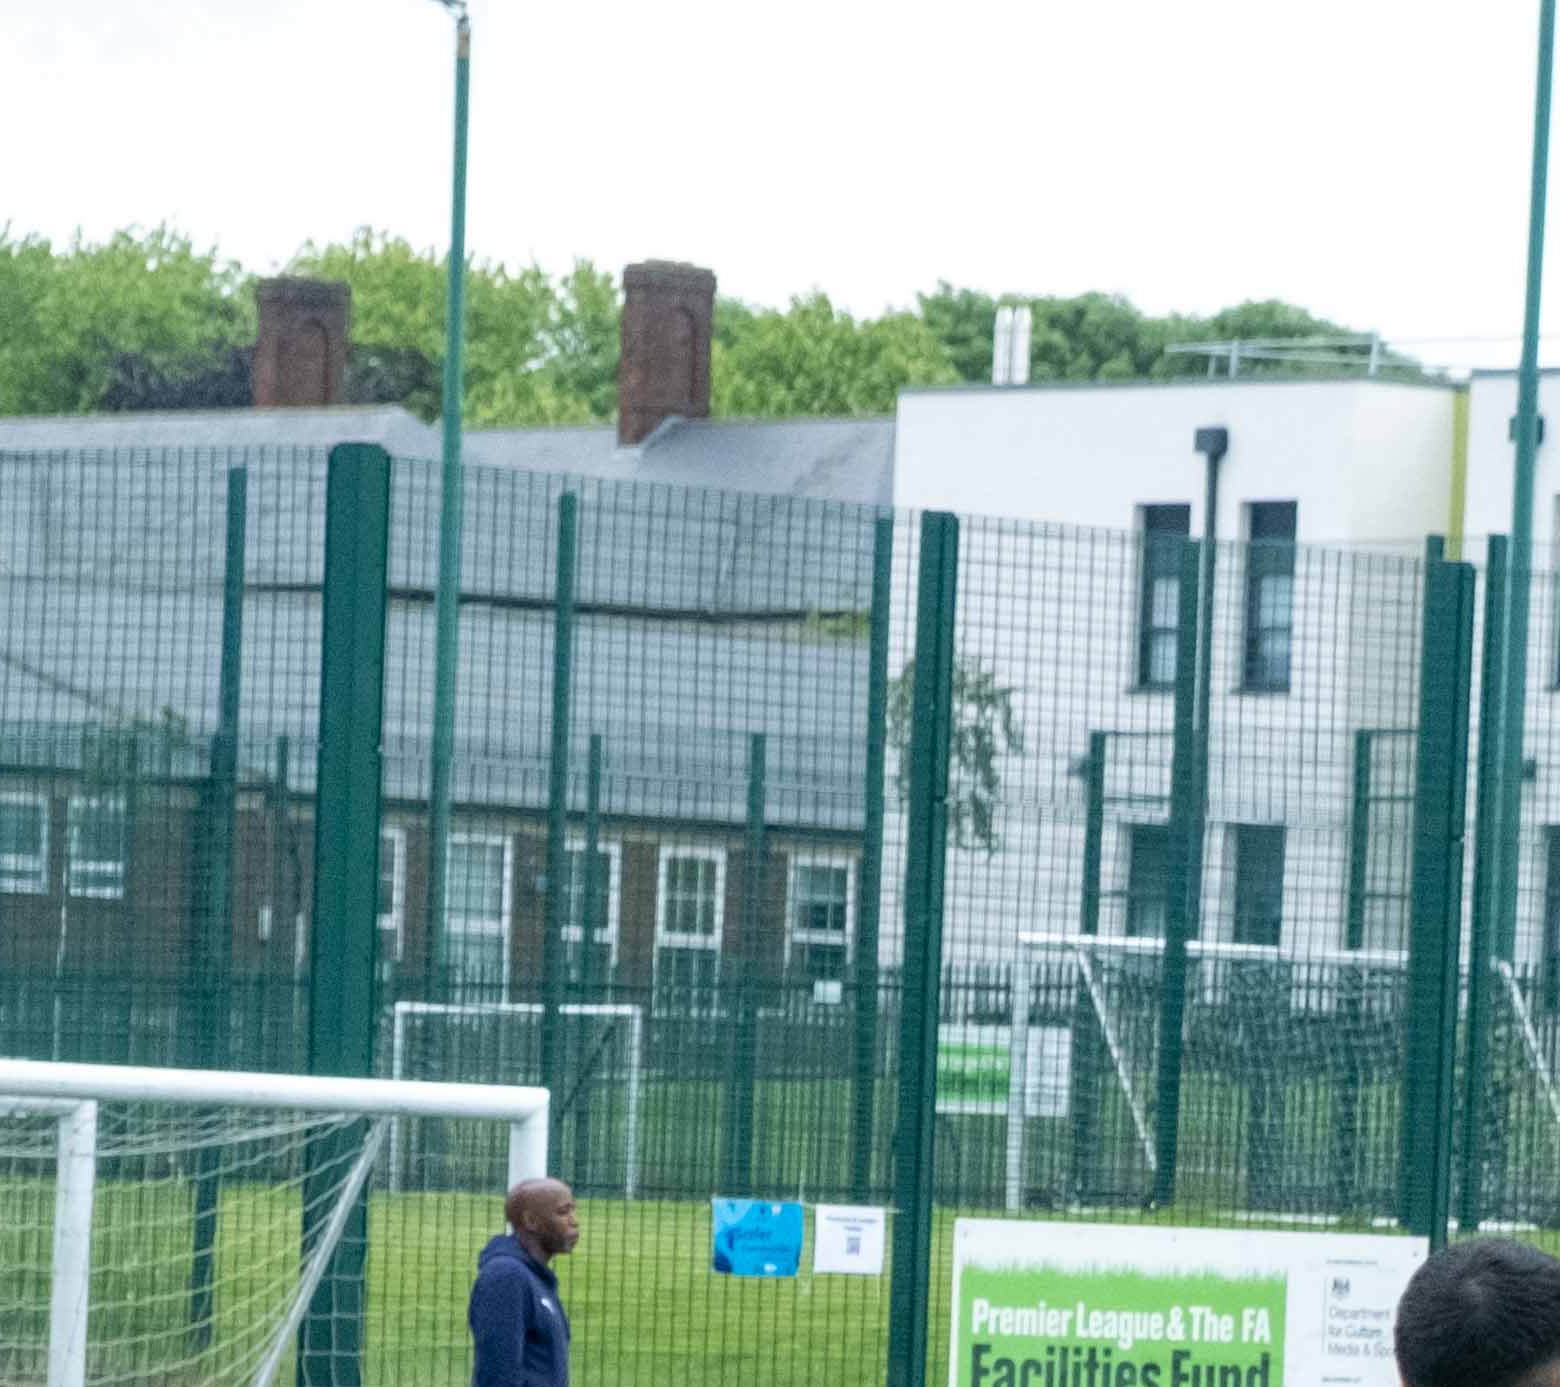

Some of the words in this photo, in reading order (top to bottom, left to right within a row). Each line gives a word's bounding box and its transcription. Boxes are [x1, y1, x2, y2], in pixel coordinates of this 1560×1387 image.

[972, 1298, 1073, 1337] Premier
[1076, 1301, 1163, 1350] League
[1166, 1306, 1185, 1341] &
[1189, 1306, 1234, 1342] The
[1241, 1307, 1271, 1344] FA
